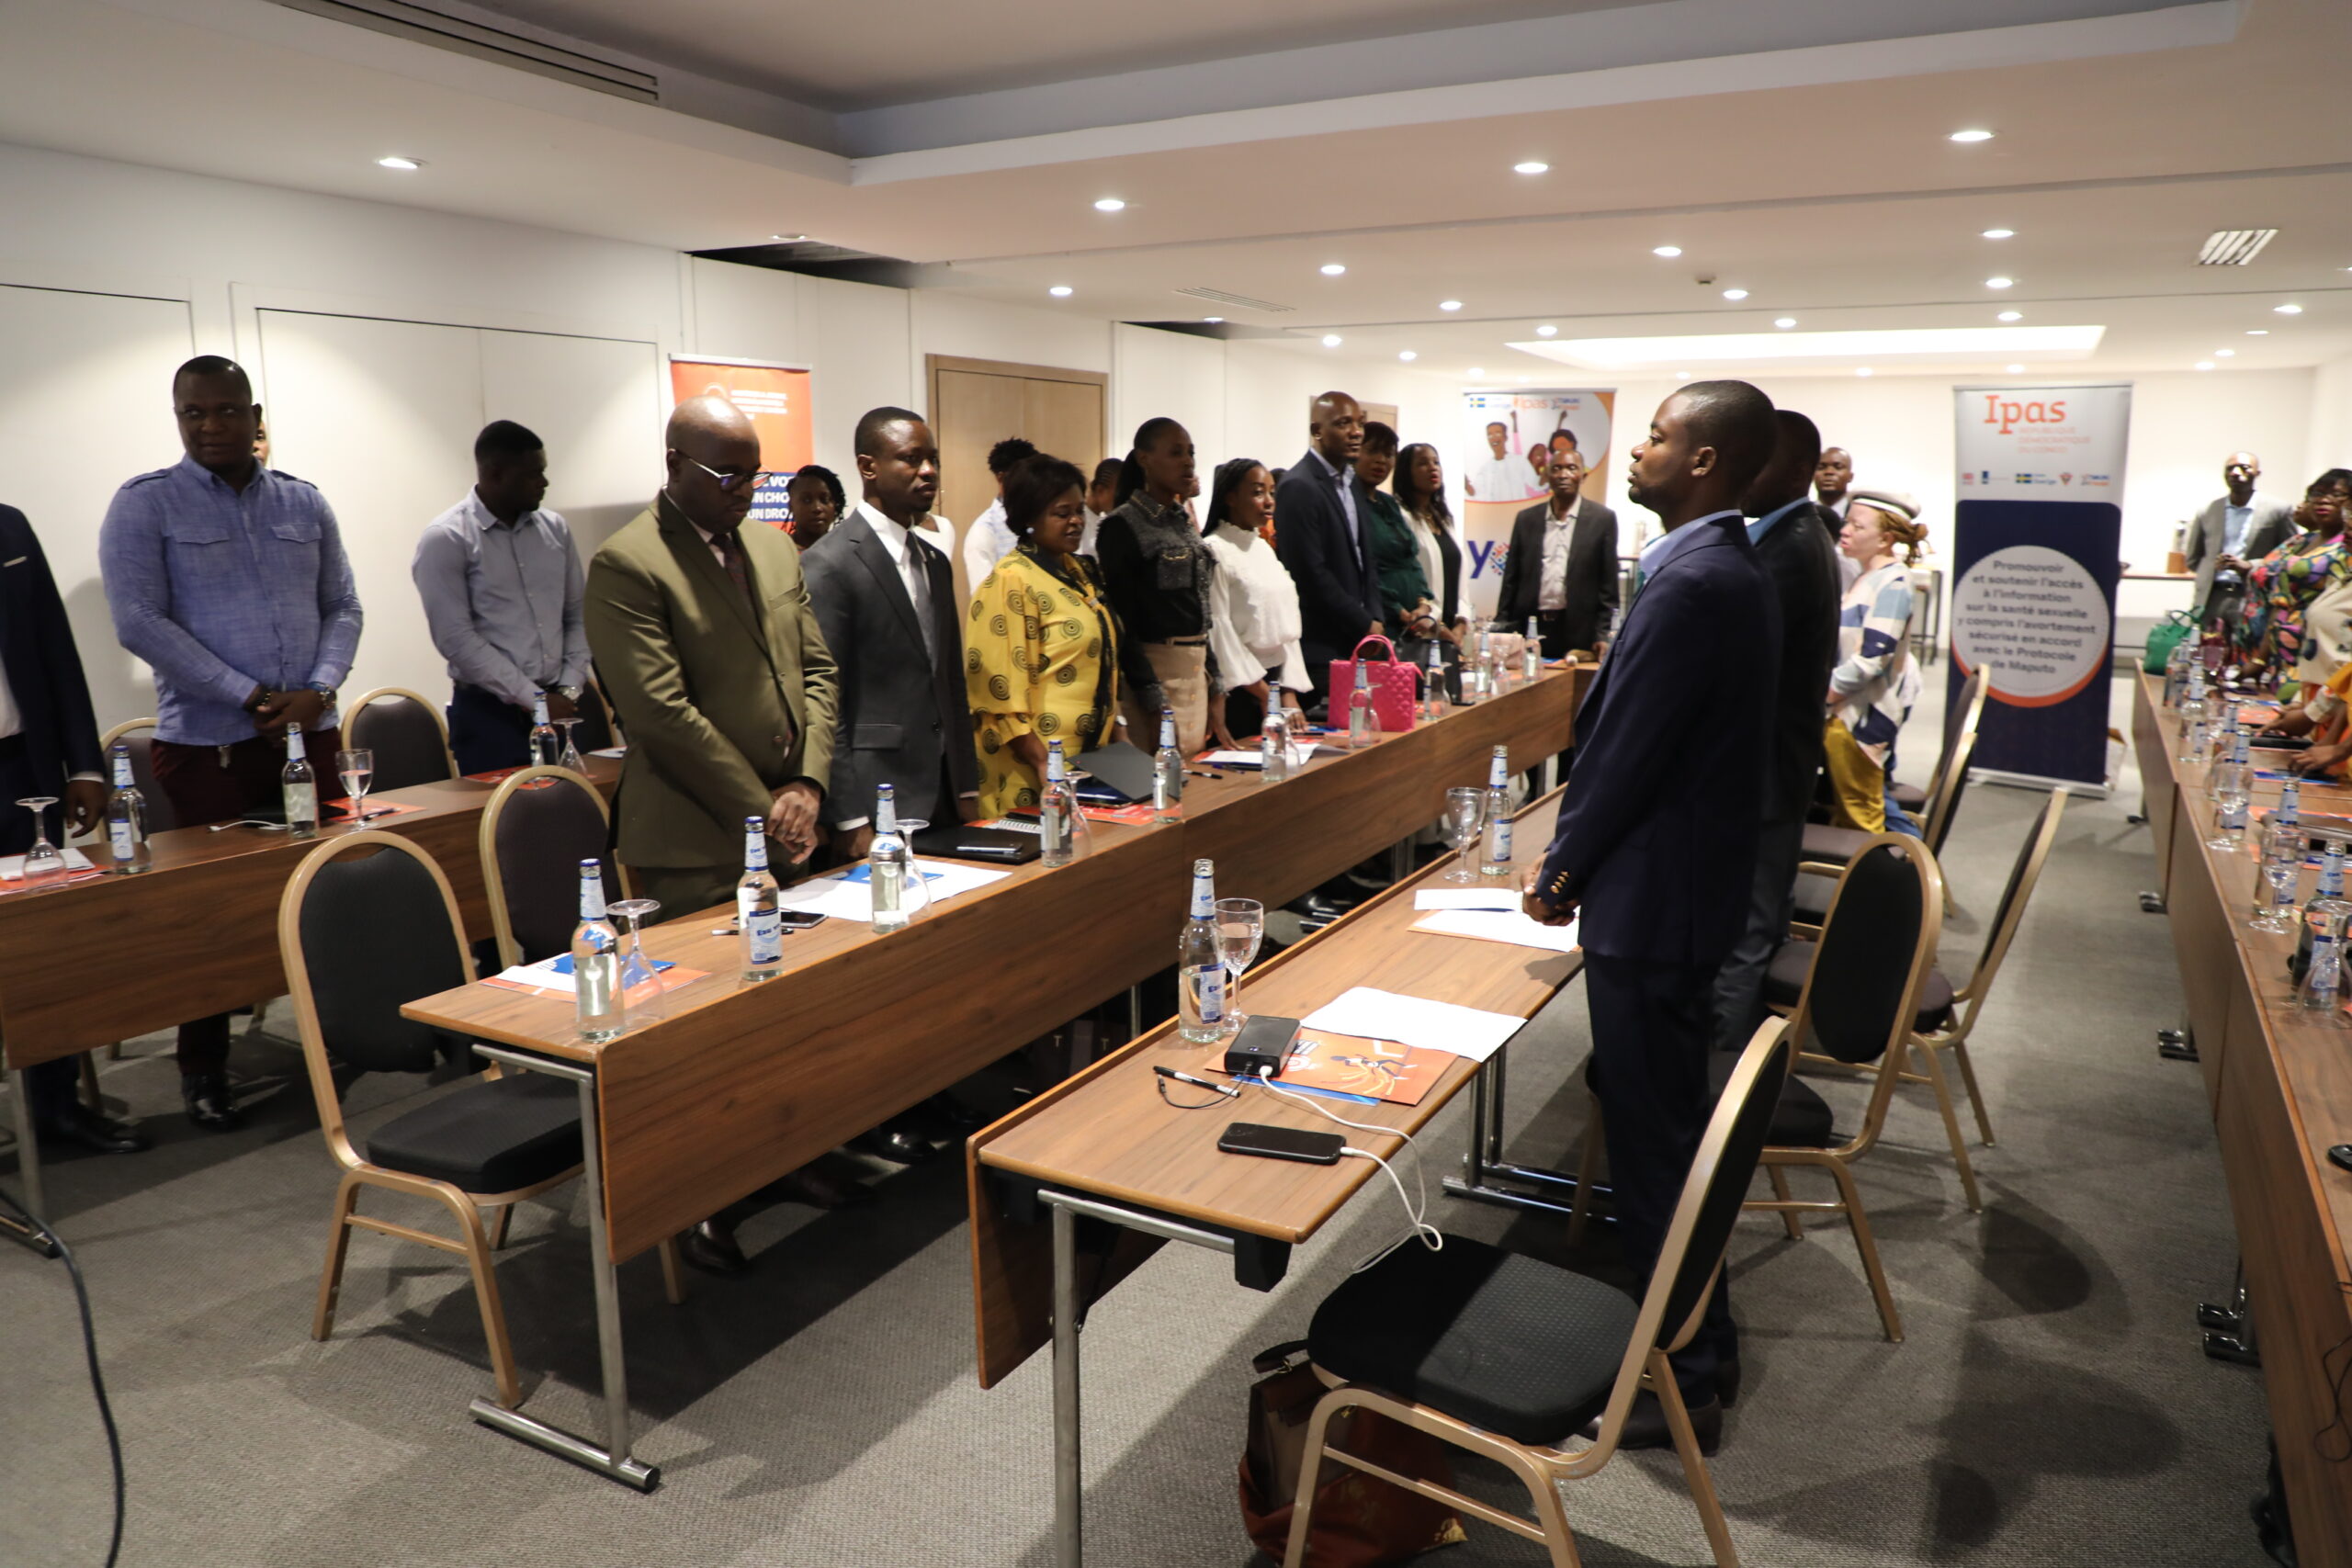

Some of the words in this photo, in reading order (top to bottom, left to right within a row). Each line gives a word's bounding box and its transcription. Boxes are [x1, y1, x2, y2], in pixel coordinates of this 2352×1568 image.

[1984, 395, 2066, 434] Ipas
[1994, 560, 2064, 573] Promouvoir
[1972, 575, 1984, 583] et
[1988, 574, 2038, 586] soutenir
[2041, 577, 2084, 590] l'accès
[1993, 589, 2072, 603] l'information
[1965, 604, 1984, 612] sur
[1987, 603, 1998, 612] la
[2002, 604, 2034, 615] santé
[2038, 607, 2087, 619] sexuelle
[1966, 617, 2014, 628] compris
[2018, 619, 2096, 634] l'avortement
[2021, 635, 2037, 643] en
[2040, 636, 2083, 648] accord
[1973, 646, 2000, 655] avec
[2003, 646, 2014, 656] le
[2017, 648, 2076, 662] Protocole
[1991, 660, 2006, 669] de
[2008, 660, 2057, 674] Maputo
